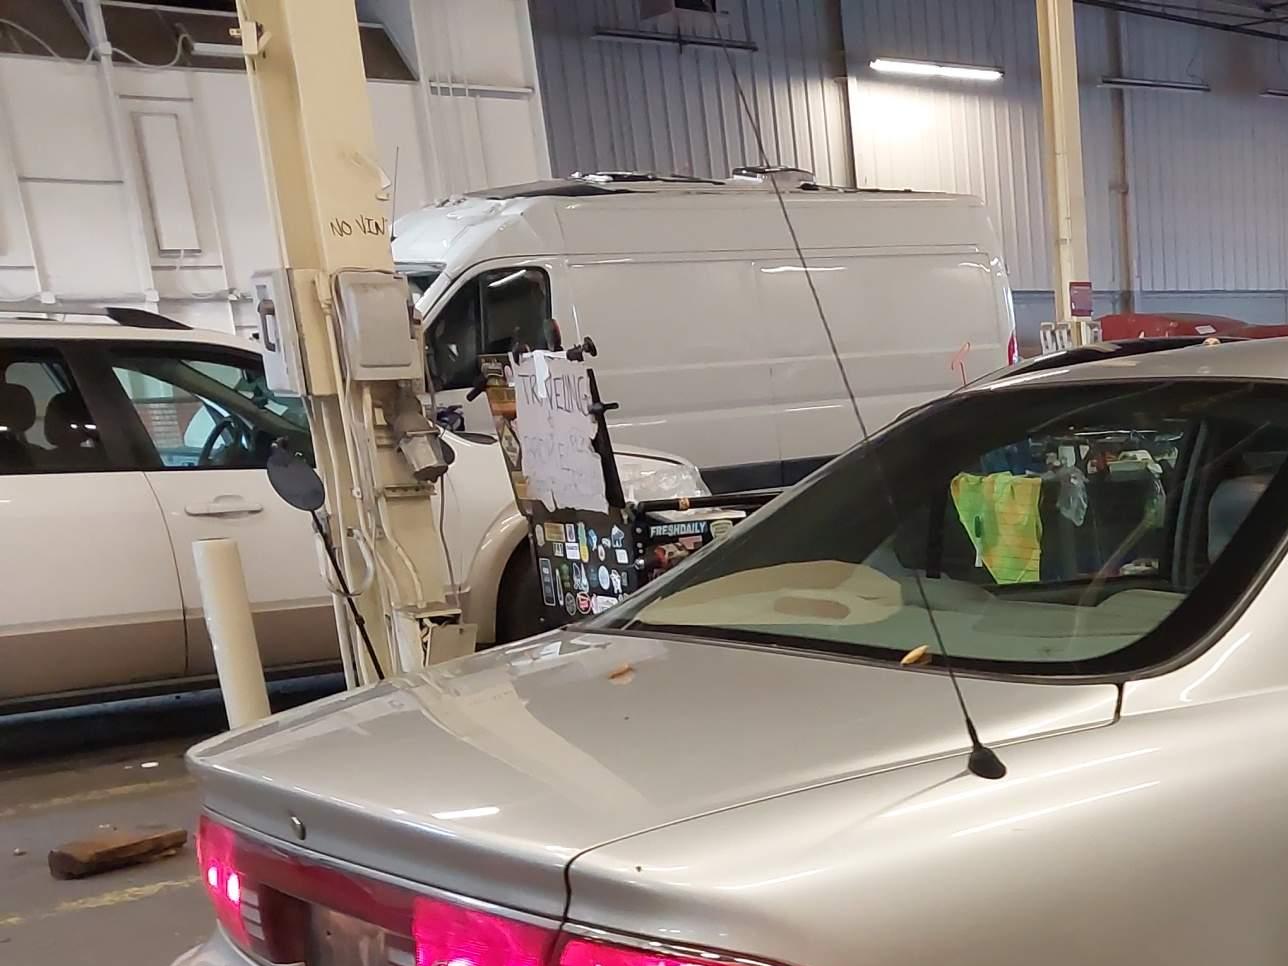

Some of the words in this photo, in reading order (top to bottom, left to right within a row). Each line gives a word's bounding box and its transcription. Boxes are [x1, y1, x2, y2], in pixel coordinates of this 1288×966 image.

[330, 218, 352, 237] NO
[355, 214, 385, 235] VIN
[650, 521, 707, 538] FRESHDAILY
